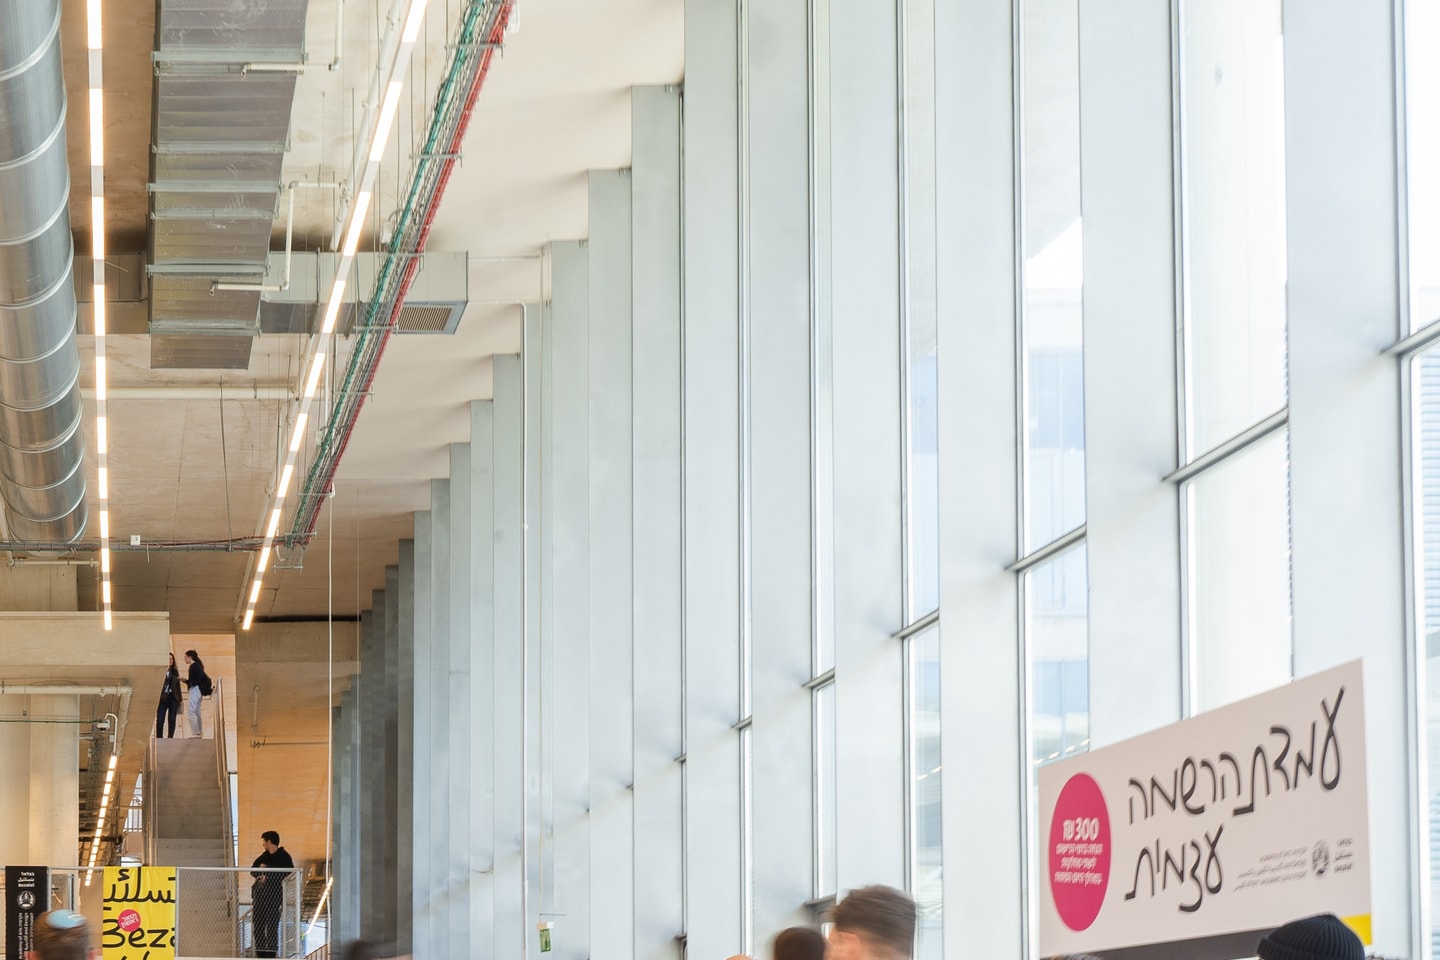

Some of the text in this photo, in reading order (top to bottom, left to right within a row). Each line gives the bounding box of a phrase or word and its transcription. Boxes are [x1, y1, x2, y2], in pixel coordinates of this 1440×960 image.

[1127, 684, 1346, 825] עמדת הרשמה
[1123, 823, 1225, 913] עצמית
[102, 919, 176, 948] Bez
